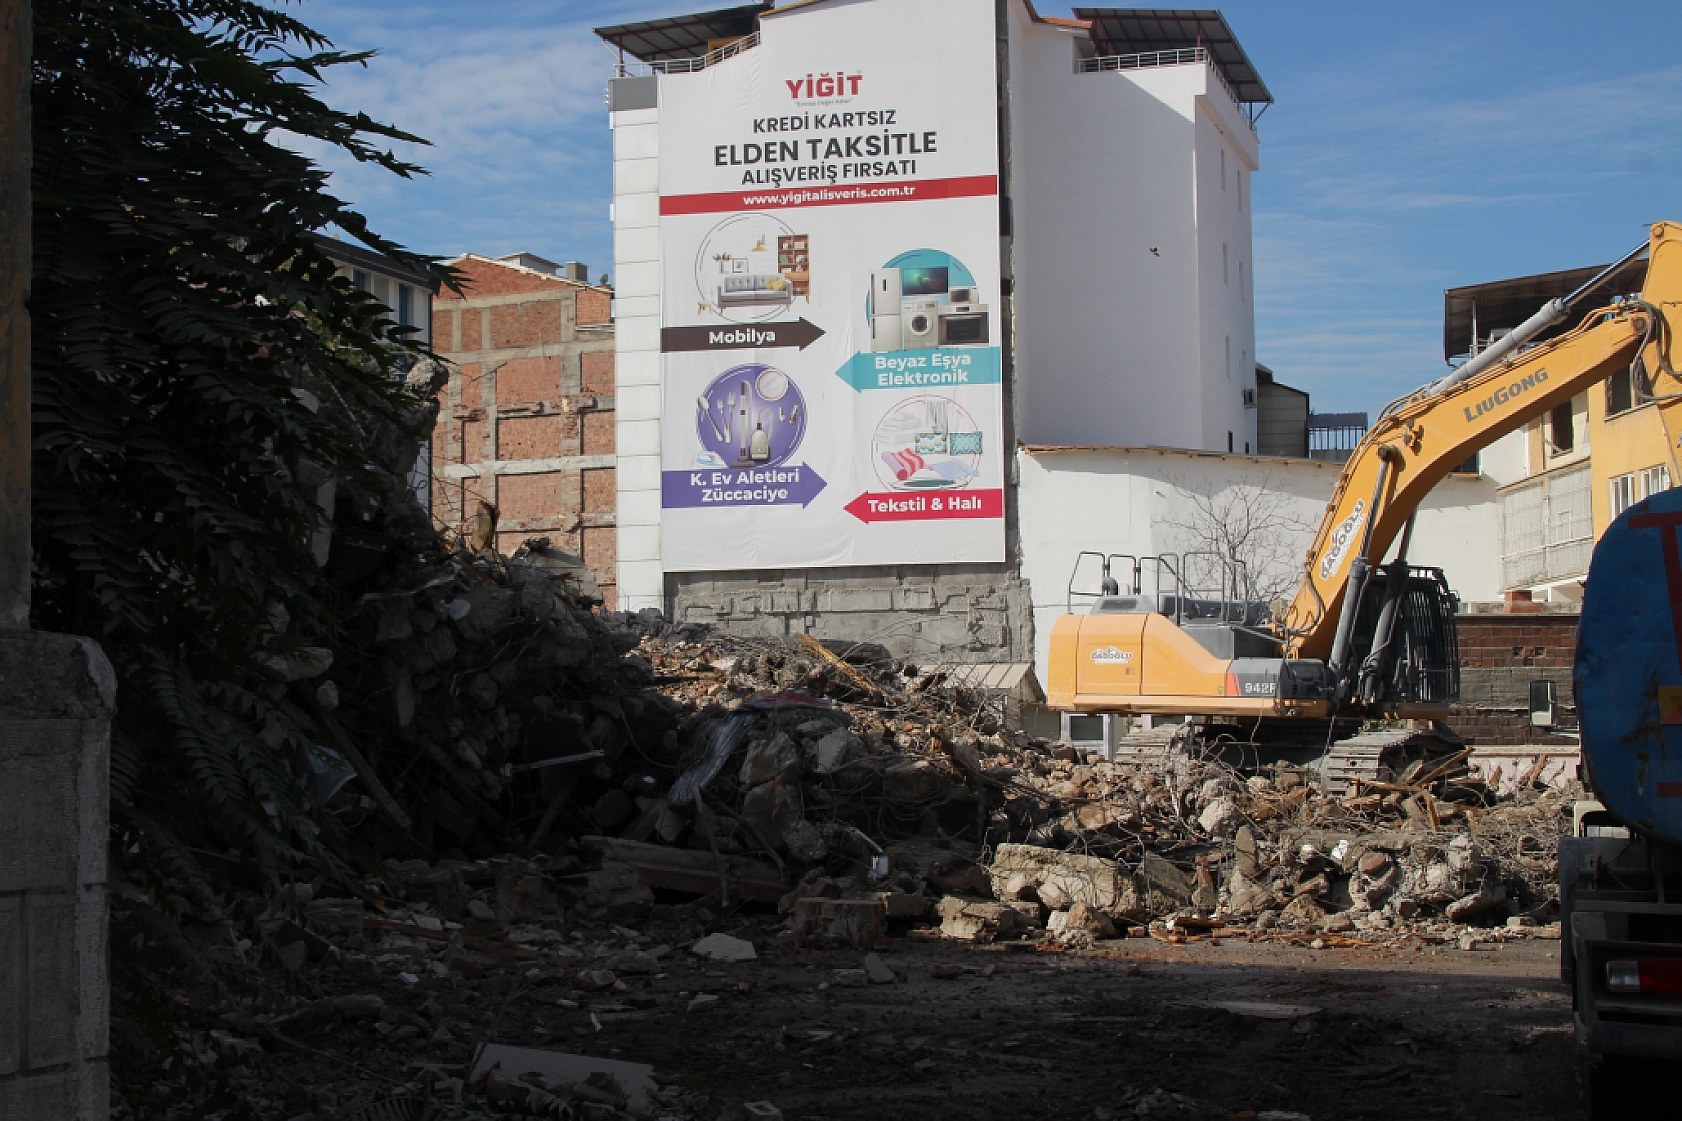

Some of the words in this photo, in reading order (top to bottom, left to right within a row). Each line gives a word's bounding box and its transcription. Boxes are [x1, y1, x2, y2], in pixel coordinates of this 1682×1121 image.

[785, 71, 863, 99] YİĞİT
[753, 111, 810, 134] KREDİ
[814, 109, 896, 130] KARTSIZ
[715, 140, 799, 166] ELDEN
[806, 128, 938, 161] TAKSİTLE
[741, 161, 838, 188] ALIŞVERİŞ
[843, 159, 916, 179] FIRSATI
[742, 185, 916, 205] www.yigitalisveris.com.tr
[708, 328, 776, 346] Mobilya
[875, 356, 927, 372] Beyaz
[931, 353, 972, 370] Eşya
[877, 368, 969, 387] Elektronik
[690, 474, 707, 487] K.
[712, 473, 733, 486] Ev
[737, 468, 800, 485] Aletleri
[702, 488, 789, 504] Züccaciye
[867, 497, 926, 513] Tekstil
[931, 497, 943, 511] &
[949, 495, 982, 511] Halı
